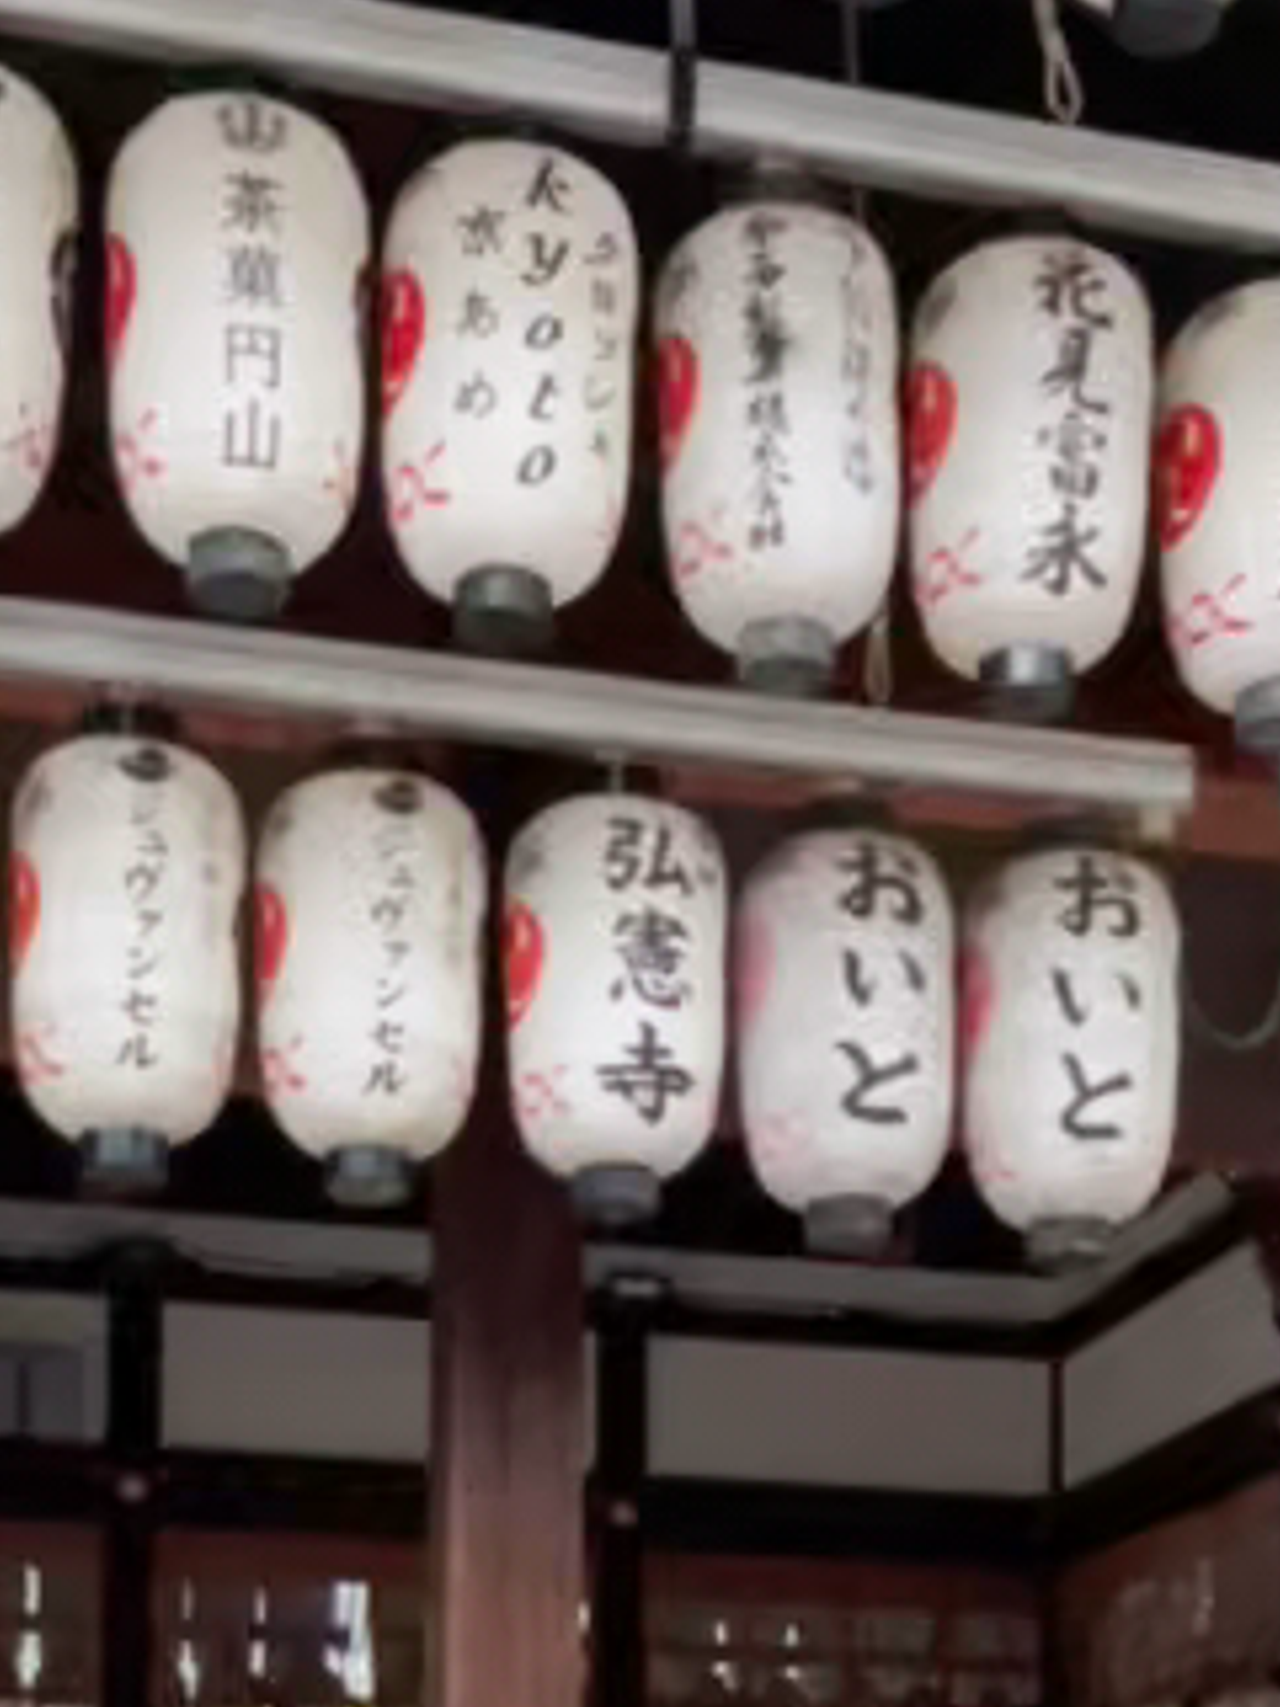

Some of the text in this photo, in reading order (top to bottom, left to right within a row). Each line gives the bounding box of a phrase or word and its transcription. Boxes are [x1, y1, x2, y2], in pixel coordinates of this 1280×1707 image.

[596, 813, 696, 1125] 弘憲寺
[832, 841, 926, 1125] おいと
[1052, 855, 1140, 1141] おいと
